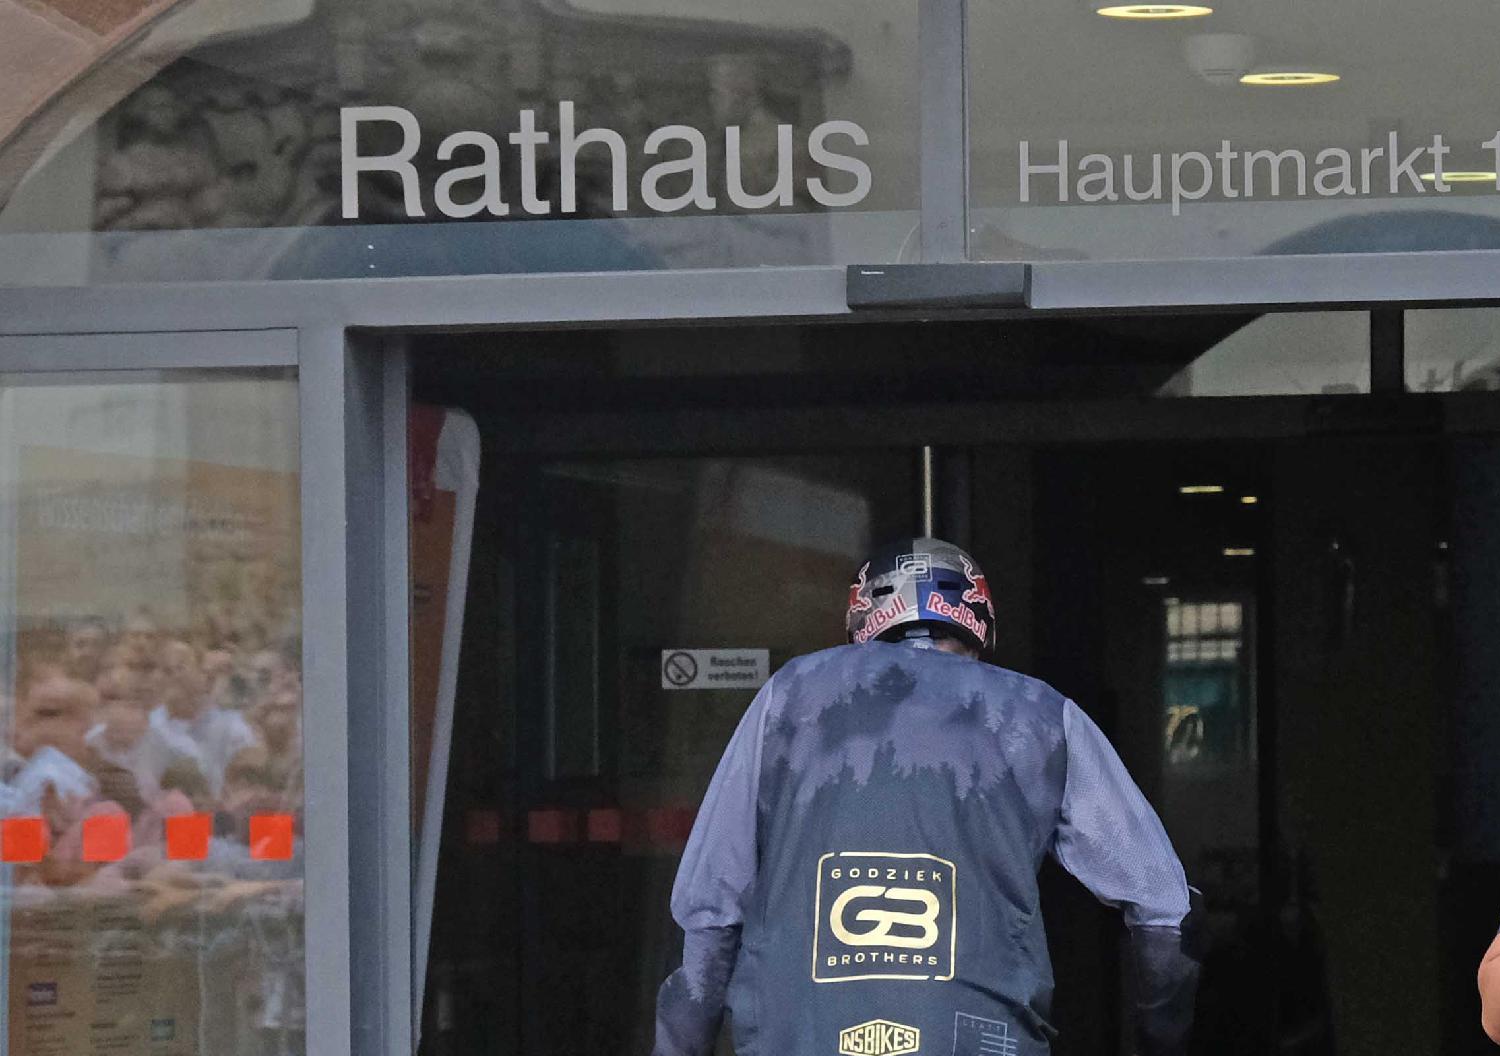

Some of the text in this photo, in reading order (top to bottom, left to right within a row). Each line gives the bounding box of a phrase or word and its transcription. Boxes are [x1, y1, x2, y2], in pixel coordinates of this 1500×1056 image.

[339, 100, 873, 220] Rathaus
[1019, 131, 1451, 216] Hauptmarkt
[830, 867, 943, 883] GODZIEK
[829, 884, 941, 949] GB
[827, 951, 938, 967] BROTHERS
